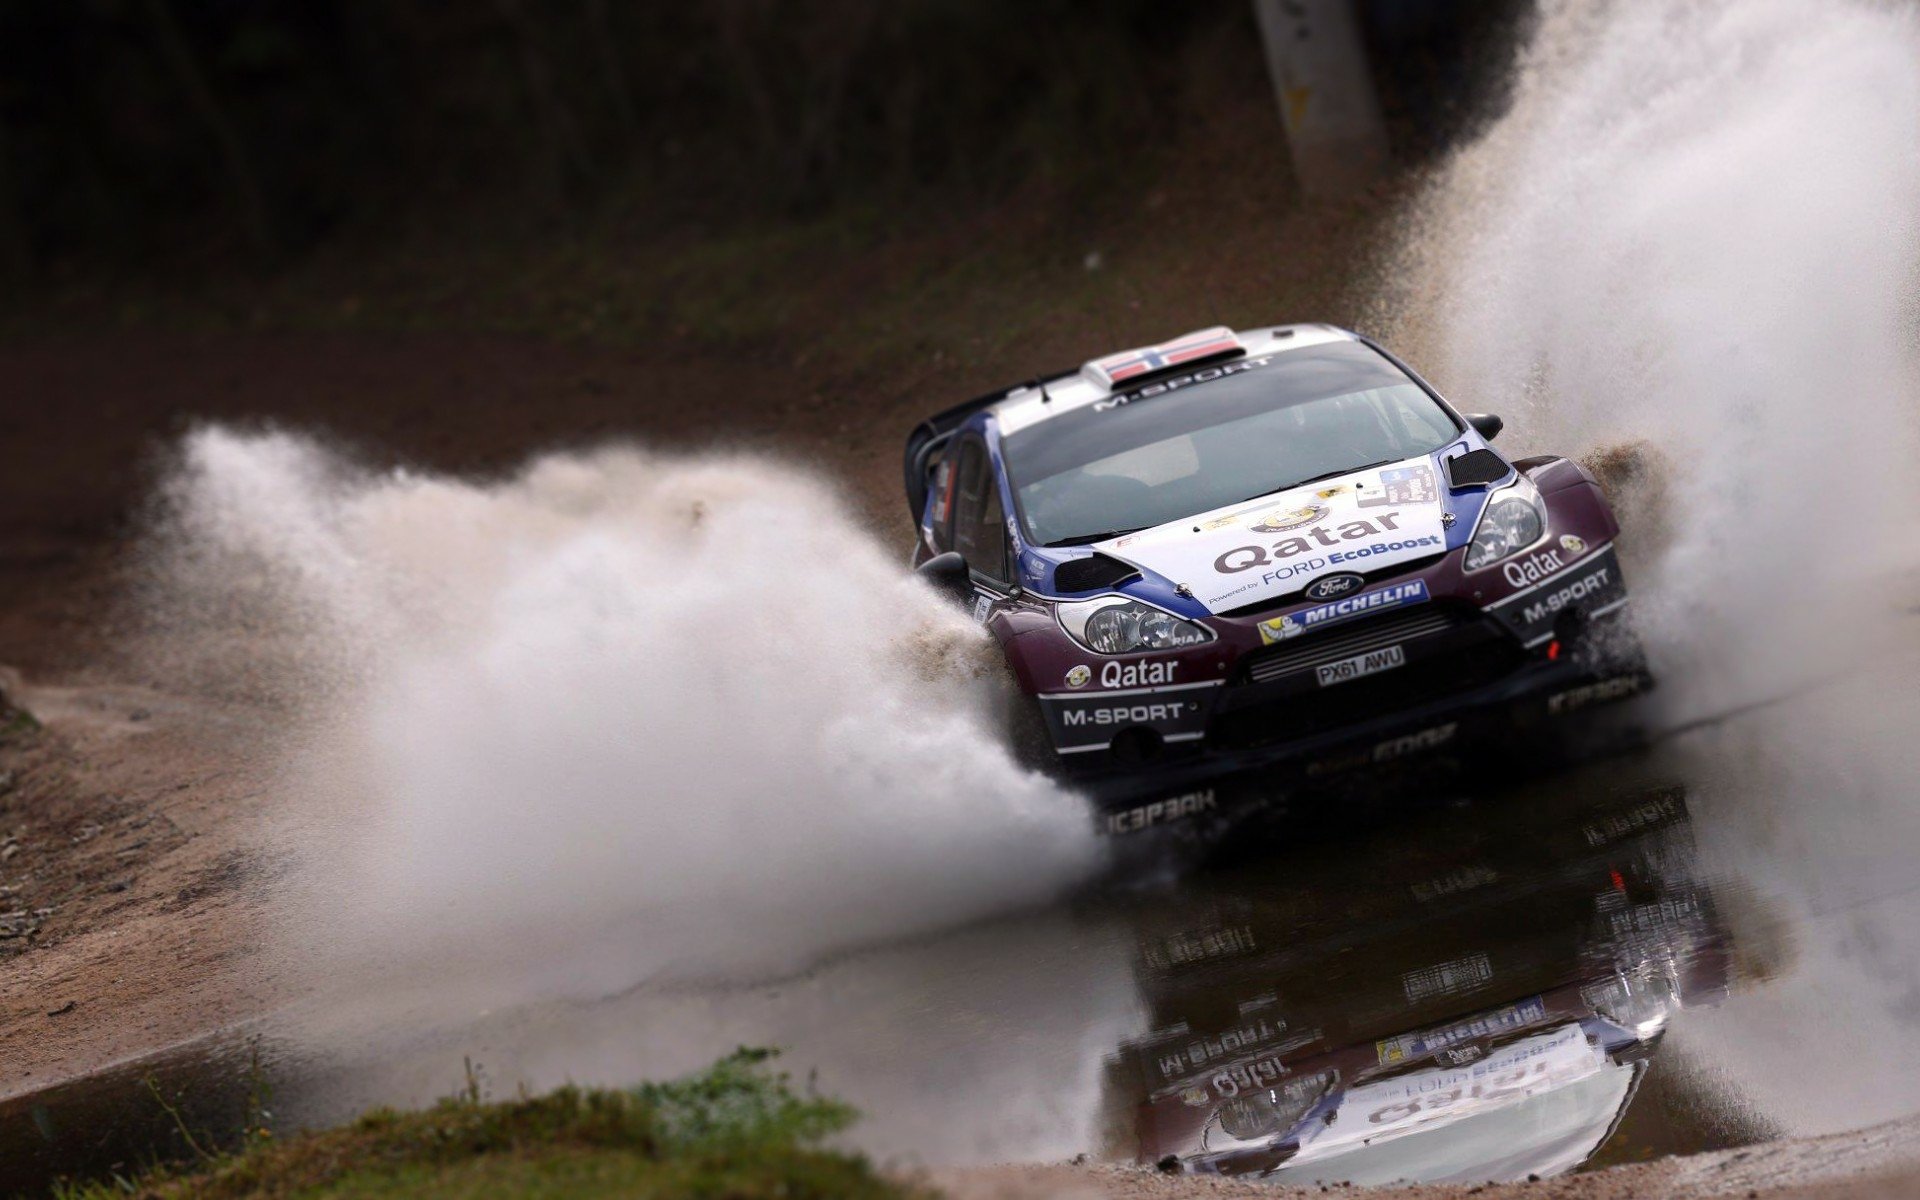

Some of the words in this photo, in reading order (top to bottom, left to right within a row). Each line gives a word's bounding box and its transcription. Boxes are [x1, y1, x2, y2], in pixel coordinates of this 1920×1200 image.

[1213, 511, 1400, 575] Qatar
[1209, 585, 1247, 604] Powered
[1248, 582, 1258, 590] by
[1262, 558, 1326, 585] FORD
[1327, 534, 1442, 565] EcoBoost
[1318, 578, 1351, 597] Ford
[1503, 549, 1564, 588] Qatar
[1304, 582, 1422, 625] MICHELIN
[1523, 568, 1609, 623] M-SPORT
[1101, 658, 1179, 688] Qatar
[1319, 661, 1358, 684] PX61
[1364, 647, 1401, 672] AWU
[1063, 703, 1184, 726] M-SPORT
